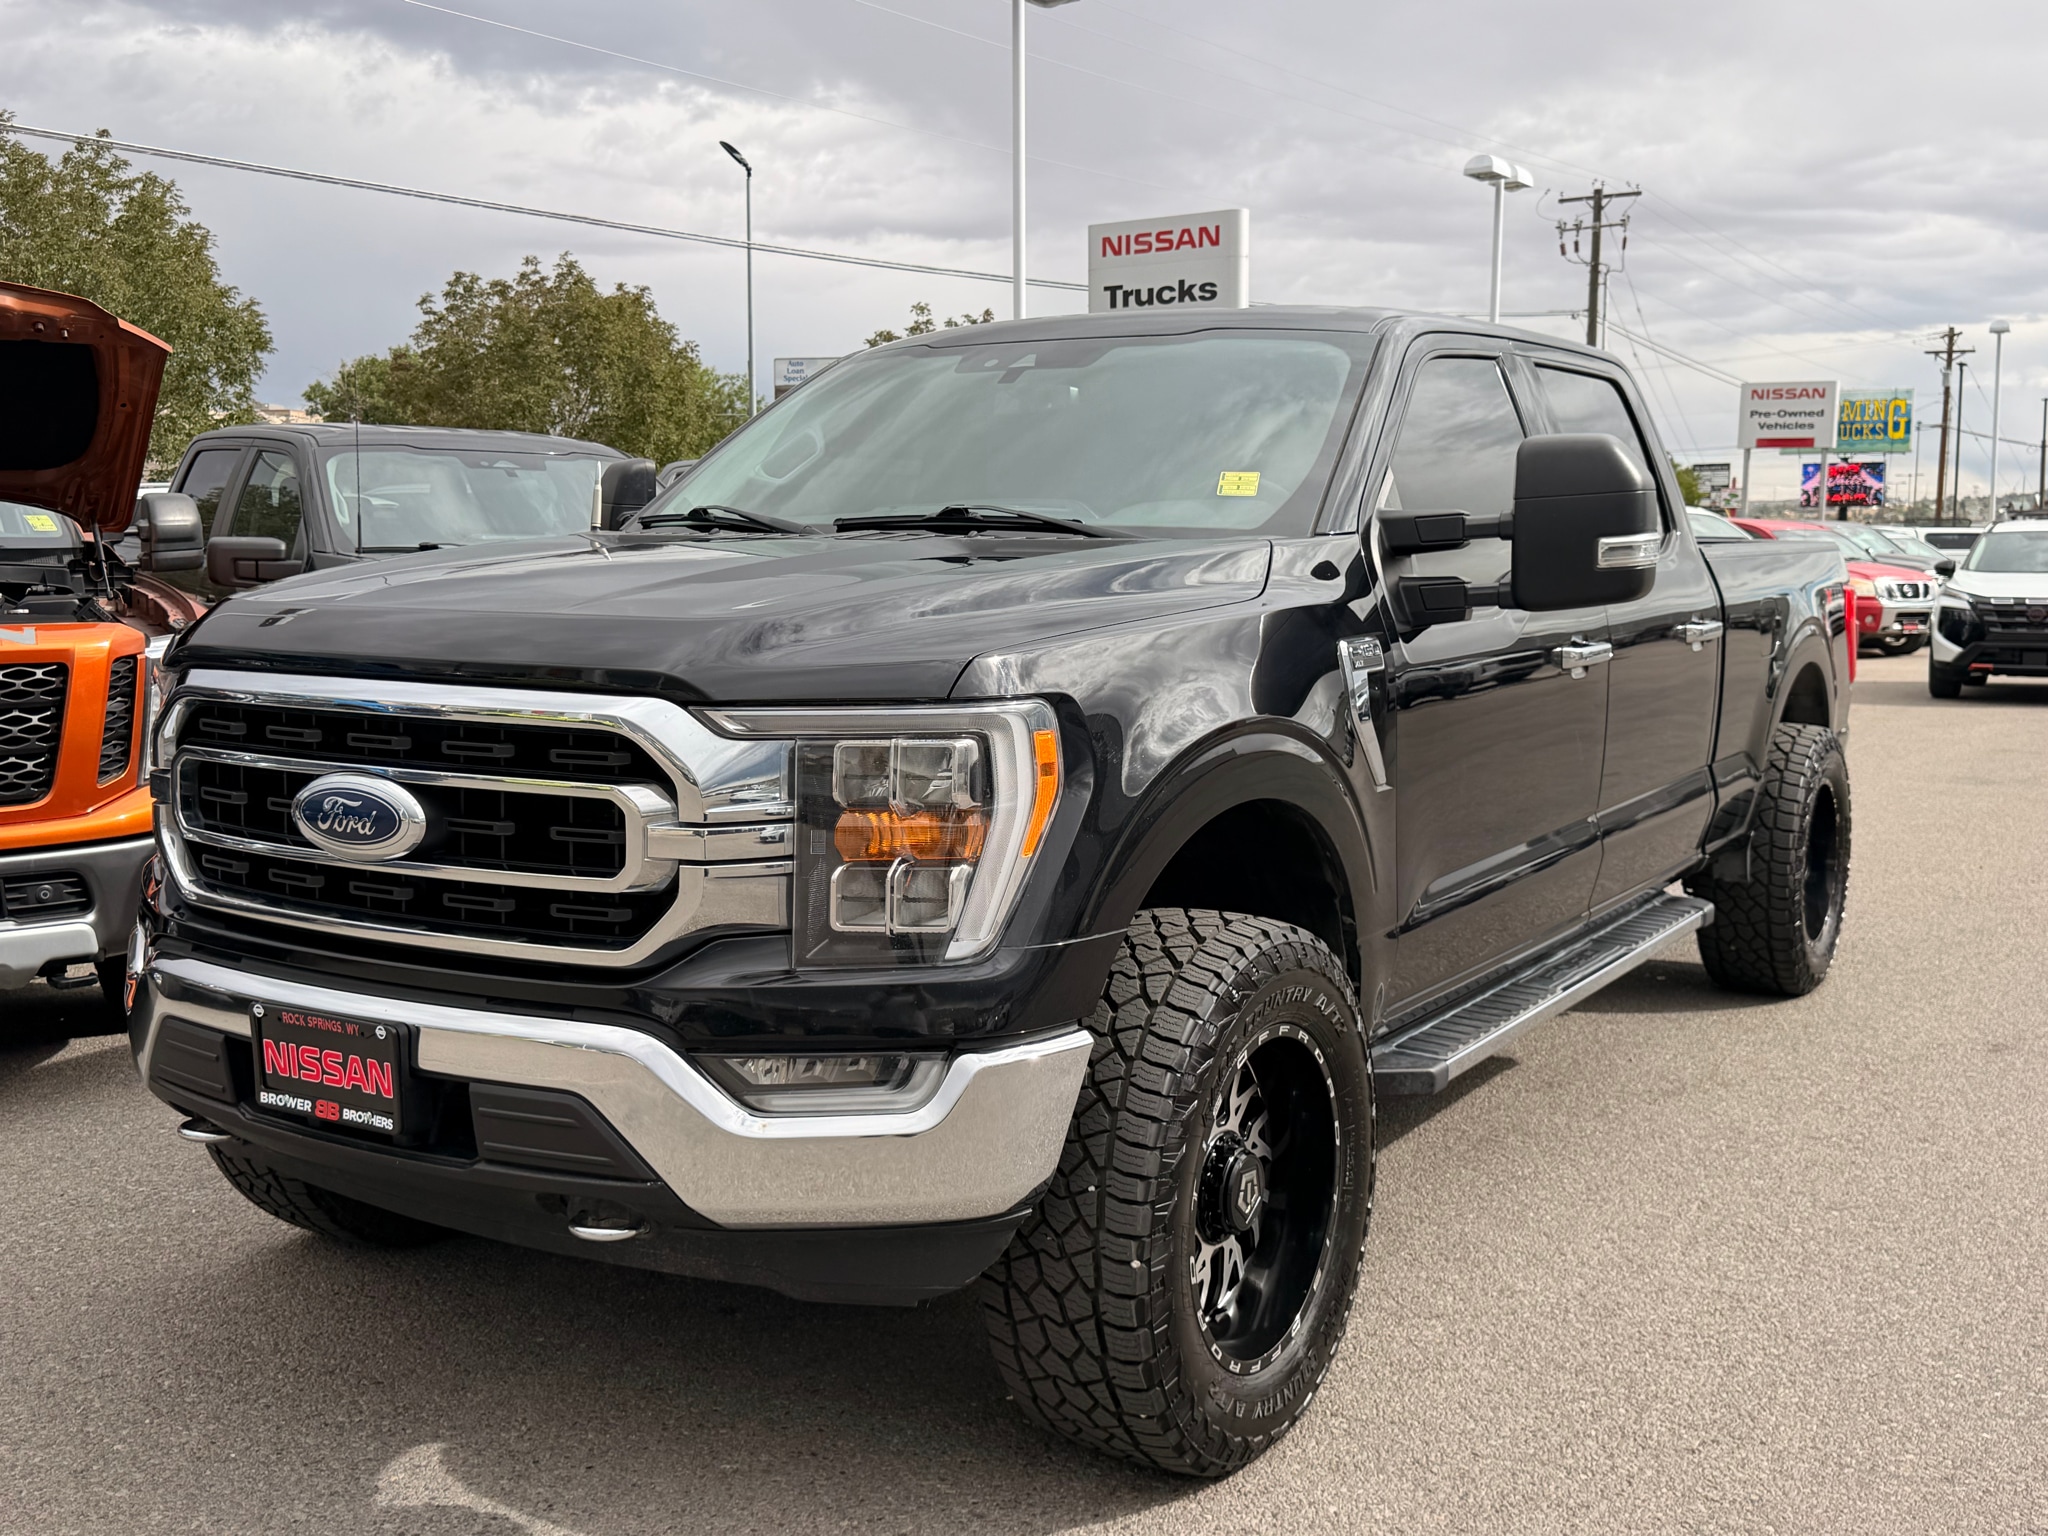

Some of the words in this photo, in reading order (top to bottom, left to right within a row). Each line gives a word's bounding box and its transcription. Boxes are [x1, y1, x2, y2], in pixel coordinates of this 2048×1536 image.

[1102, 225, 1220, 258] NISSAN
[1103, 279, 1218, 309] Trucks
[1751, 387, 1826, 400] NISSAN
[1750, 409, 1824, 419] Pre-Owned
[1758, 421, 1815, 431] Vehicles
[1840, 423, 1884, 441] UCKS
[317, 796, 377, 835] Ford
[281, 1012, 306, 1027] ROCK
[345, 1022, 359, 1037] WY
[263, 1039, 393, 1098] NISSAN
[260, 1092, 312, 1112] BROWER
[343, 1108, 393, 1130] BROTHERS
